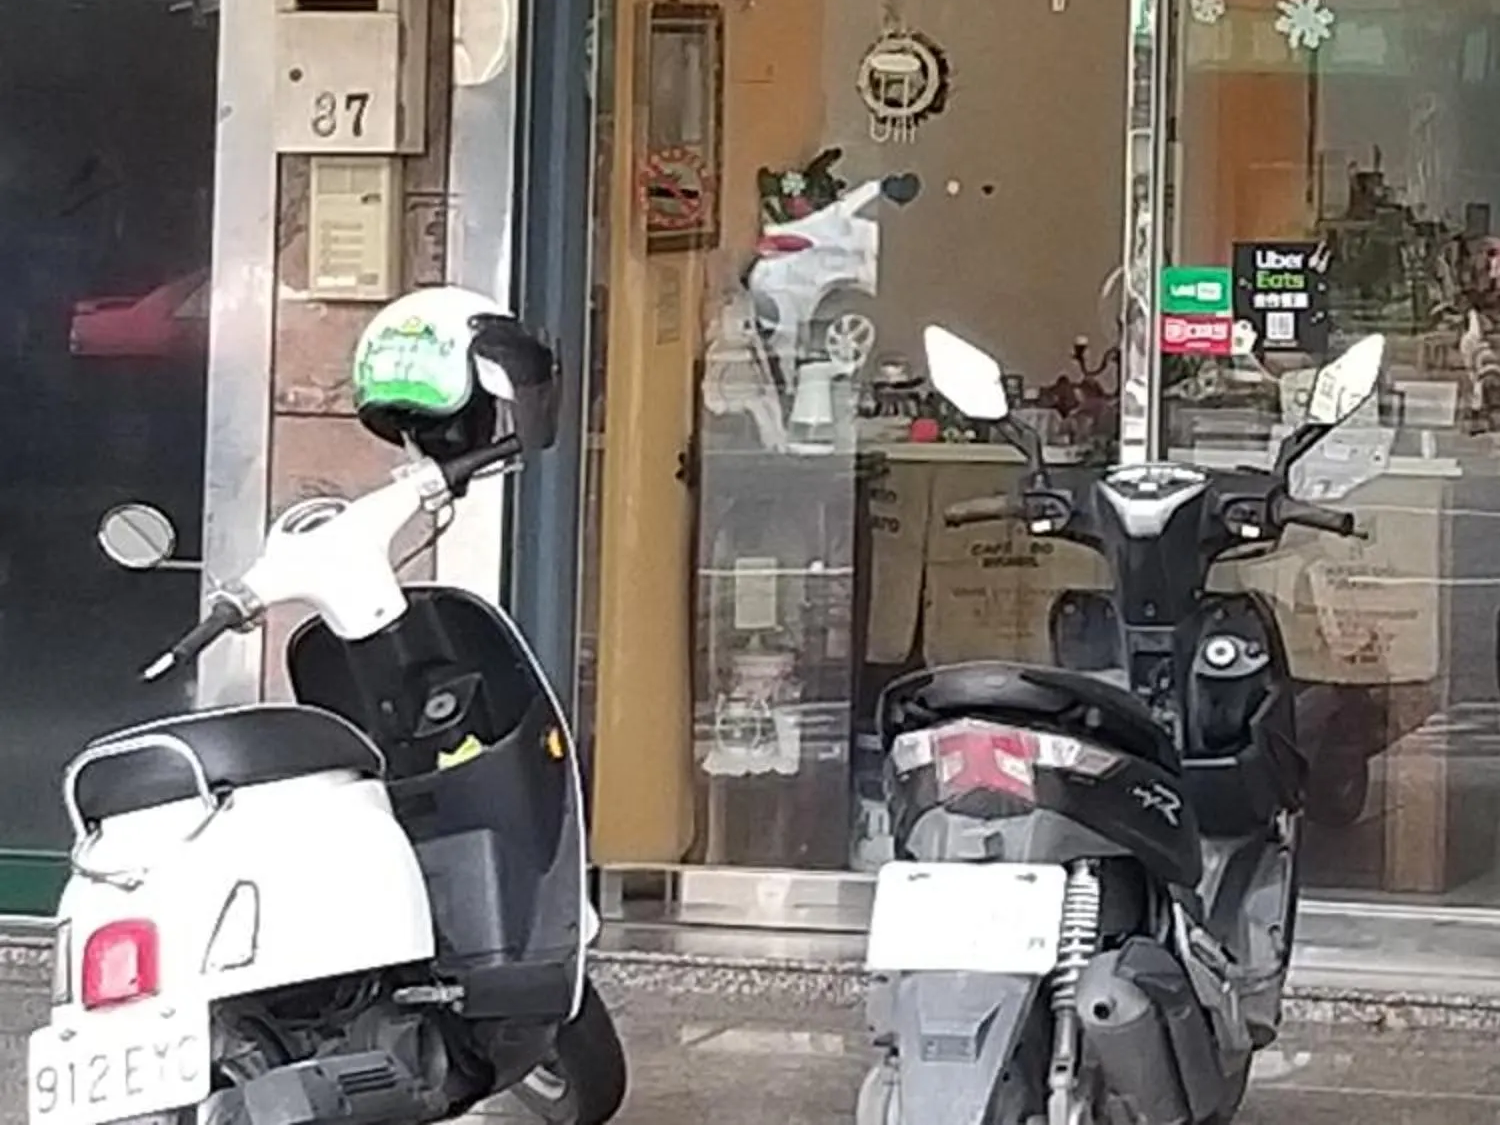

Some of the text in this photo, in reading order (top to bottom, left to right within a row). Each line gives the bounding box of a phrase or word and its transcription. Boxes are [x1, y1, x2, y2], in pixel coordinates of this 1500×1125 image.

[311, 93, 370, 137] 87
[1255, 250, 1304, 270] Uber
[1255, 271, 1305, 289] Eats
